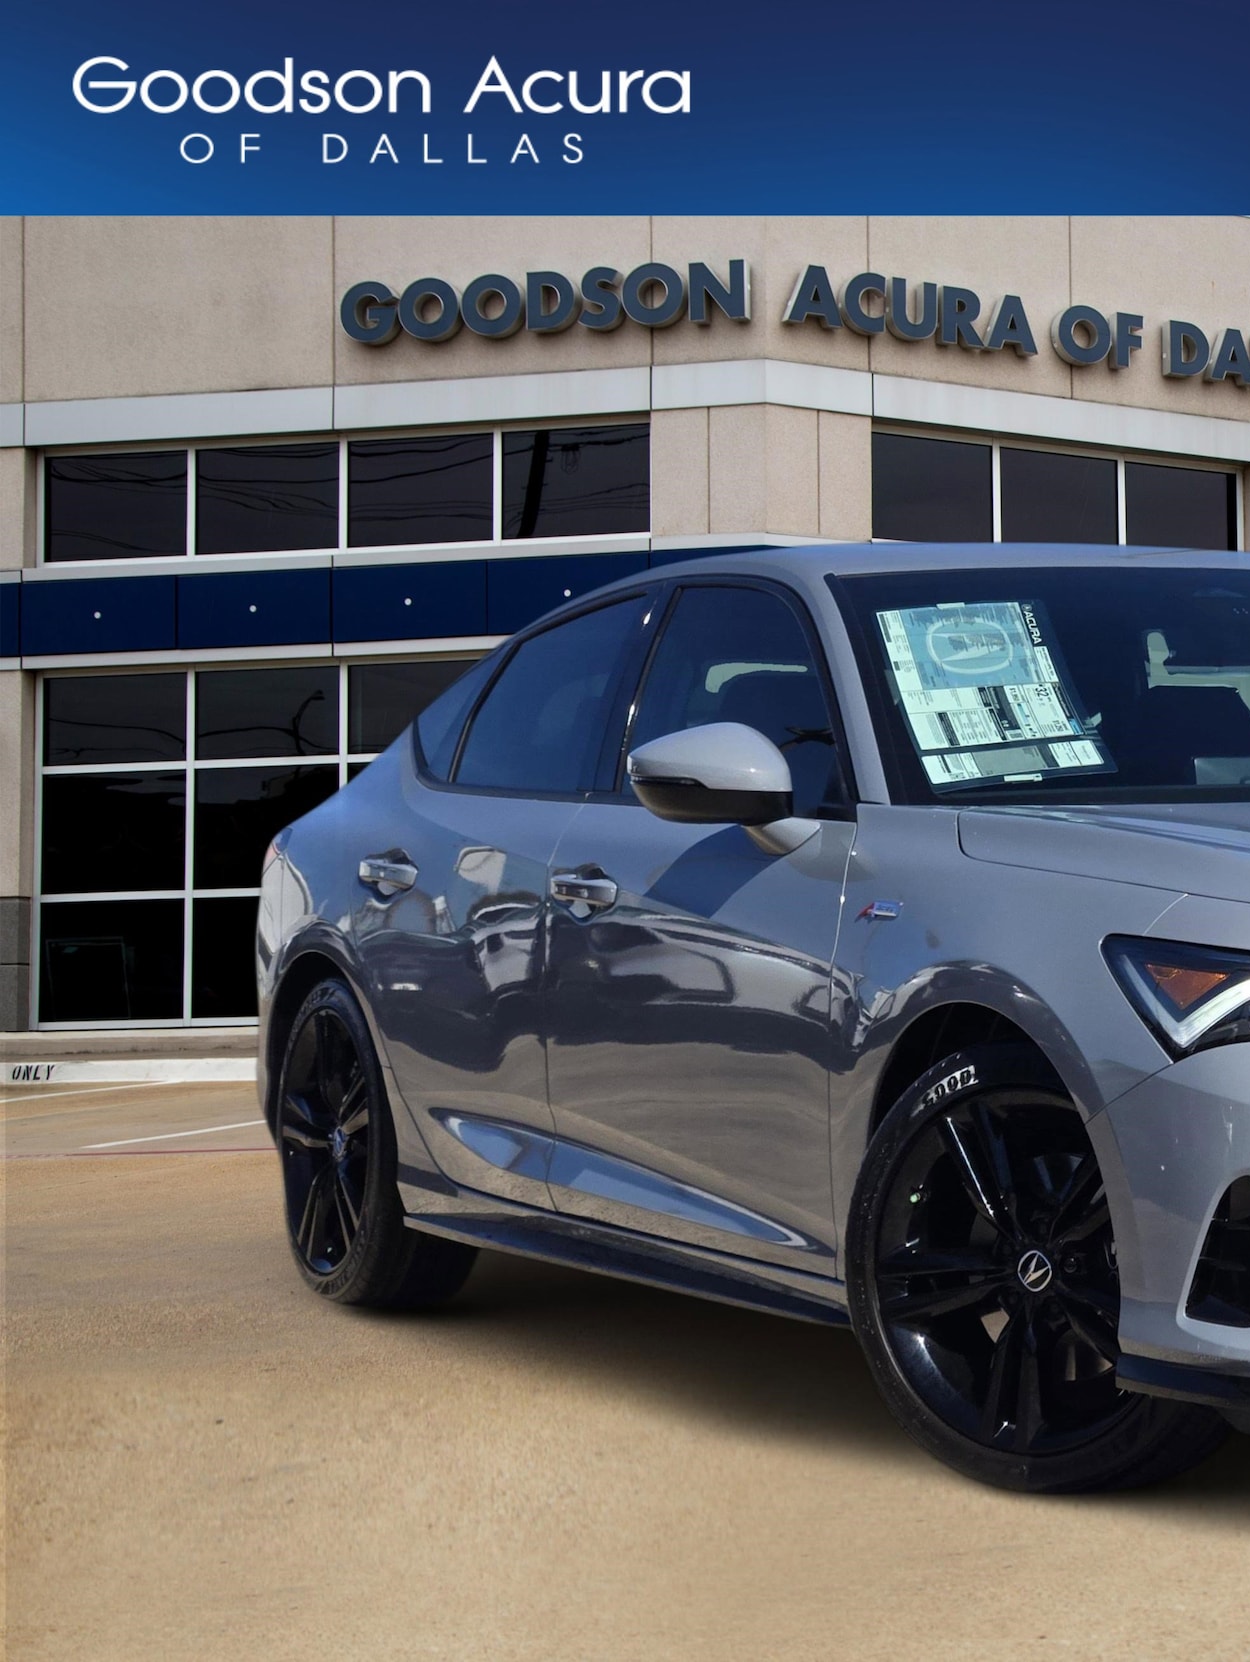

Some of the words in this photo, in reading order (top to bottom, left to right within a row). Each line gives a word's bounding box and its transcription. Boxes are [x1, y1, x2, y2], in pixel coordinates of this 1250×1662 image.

[341, 258, 752, 346] GOODSON
[781, 264, 1038, 356] ACURA
[1057, 304, 1145, 369] OF
[1023, 611, 1042, 644] ACURA
[12, 1064, 55, 1081] ONLY
